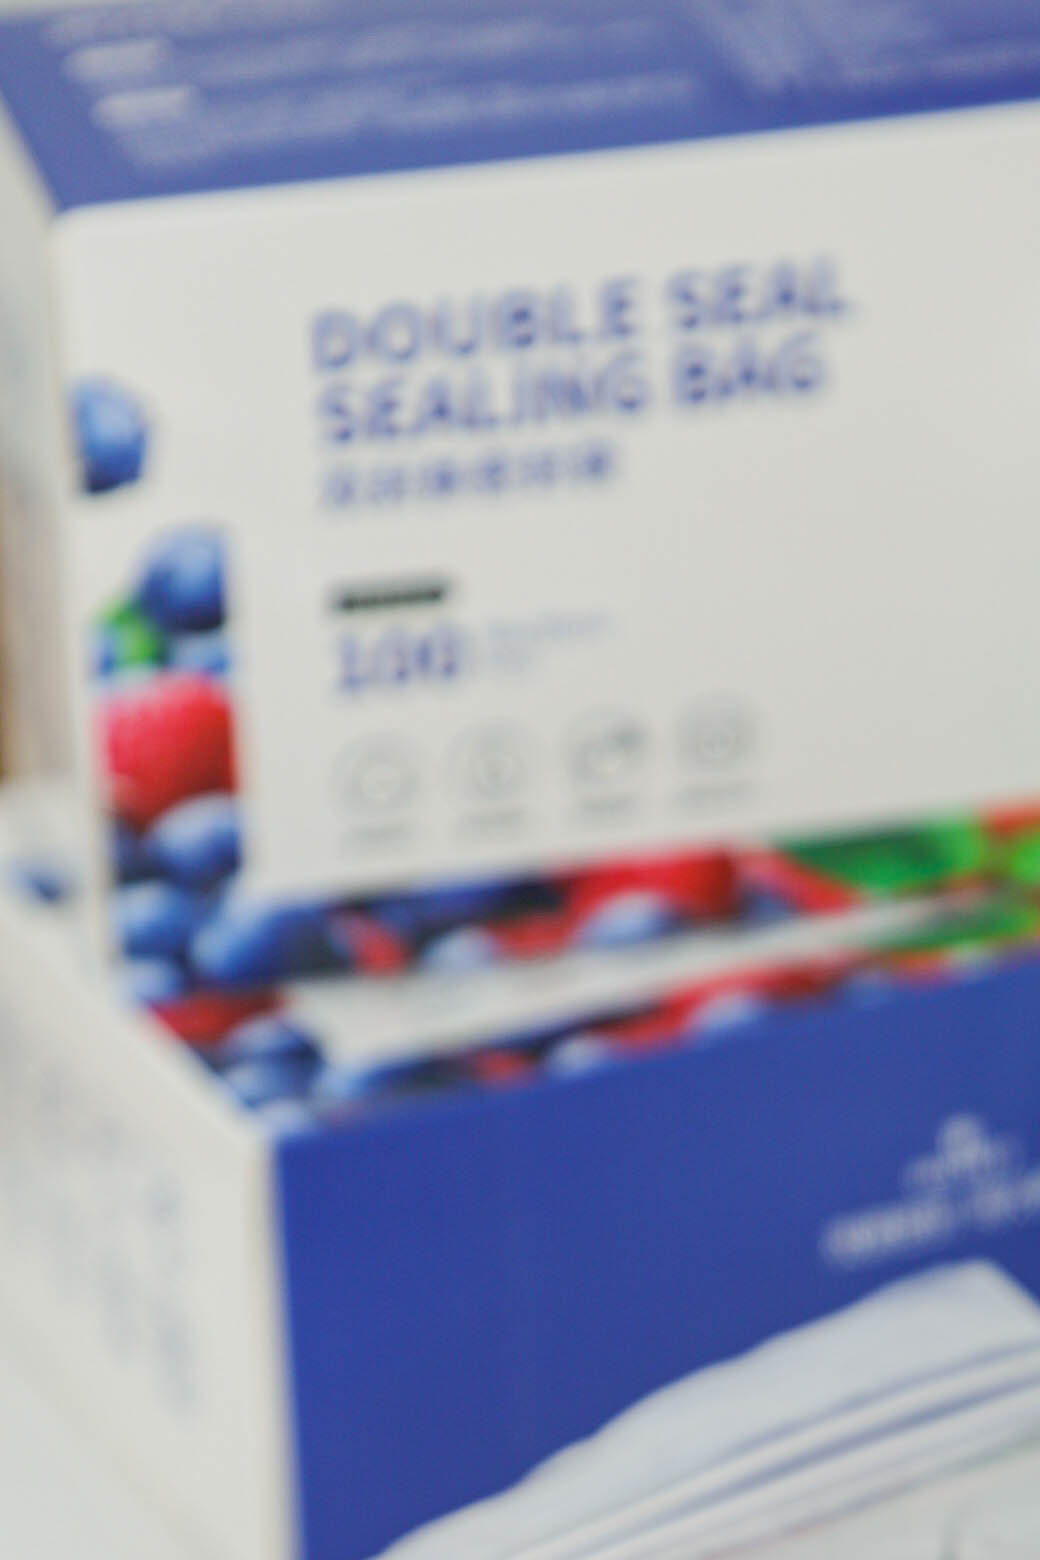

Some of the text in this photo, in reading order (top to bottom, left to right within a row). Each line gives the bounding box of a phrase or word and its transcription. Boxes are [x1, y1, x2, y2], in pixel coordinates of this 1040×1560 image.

[312, 256, 846, 370] DOUBLE SEAL
[318, 328, 824, 445] SEALING BAG
